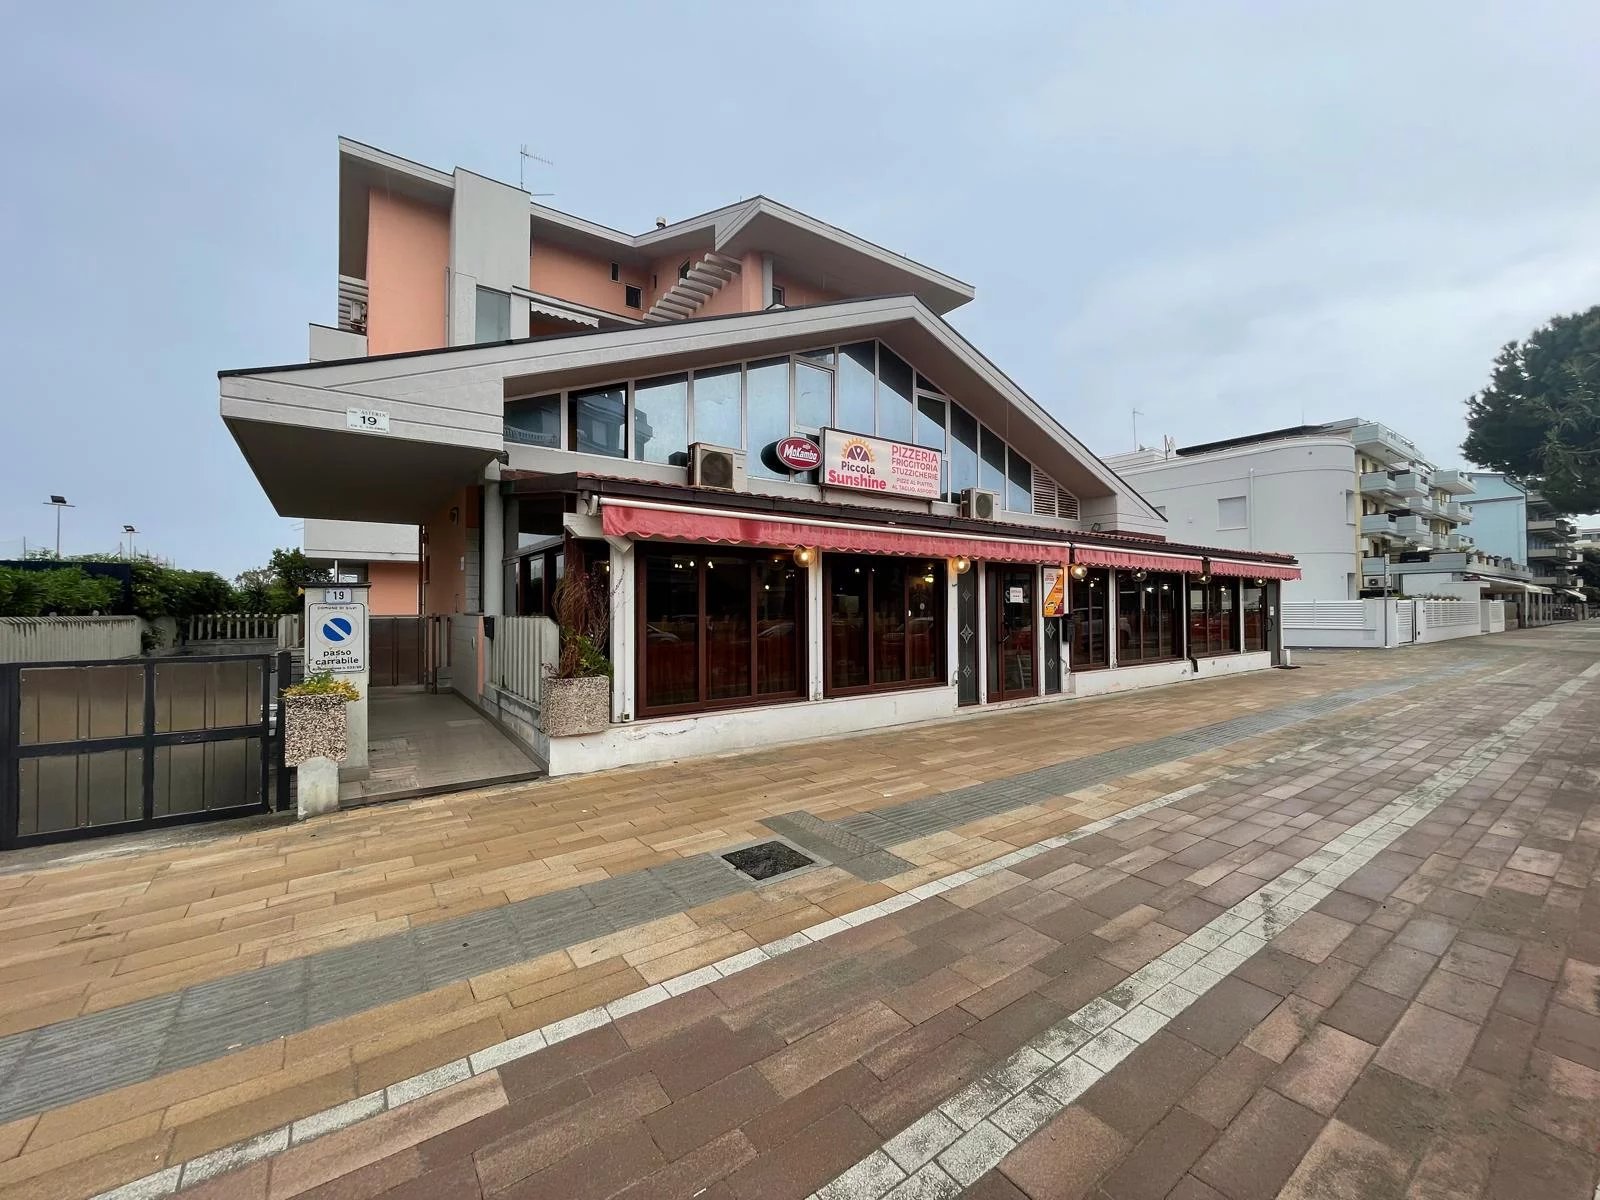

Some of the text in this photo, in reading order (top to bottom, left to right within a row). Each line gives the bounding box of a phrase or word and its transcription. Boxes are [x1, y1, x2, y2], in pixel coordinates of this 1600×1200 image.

[360, 415, 377, 426] 19
[891, 445, 938, 464] PIZZERIA
[841, 460, 876, 475] Piccola
[891, 457, 938, 473] FRIGGITORIA
[828, 469, 887, 490] Sunshine
[891, 466, 938, 481] STUZZICHERIE
[333, 590, 345, 600] 19
[315, 657, 359, 666] carrabile
[323, 650, 352, 658] passo
